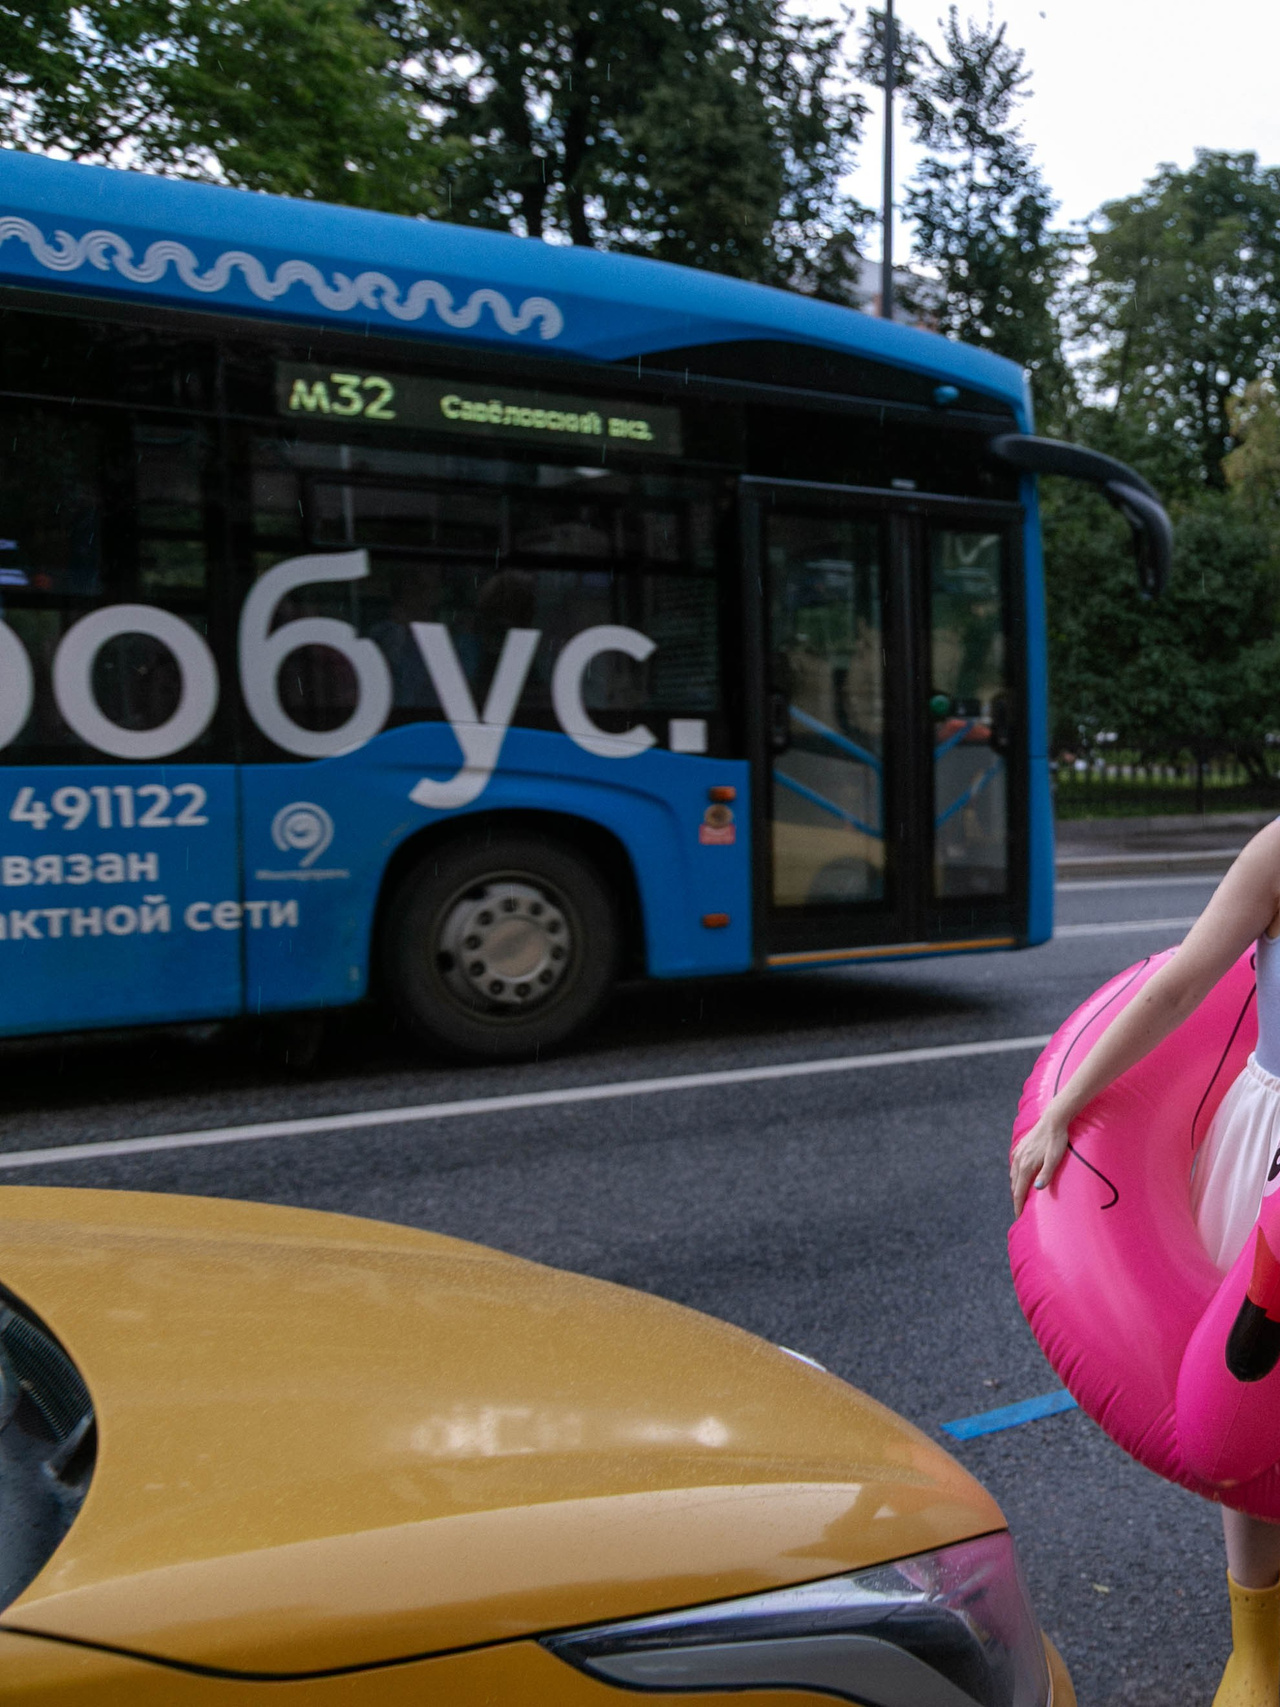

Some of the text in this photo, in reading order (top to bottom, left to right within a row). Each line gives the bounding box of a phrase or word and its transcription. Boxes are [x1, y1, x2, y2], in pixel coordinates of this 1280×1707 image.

[0, 548, 708, 810] обус.
[9, 782, 209, 831] 491122
[2, 852, 160, 887] вязан
[0, 894, 300, 941] ктной сети
